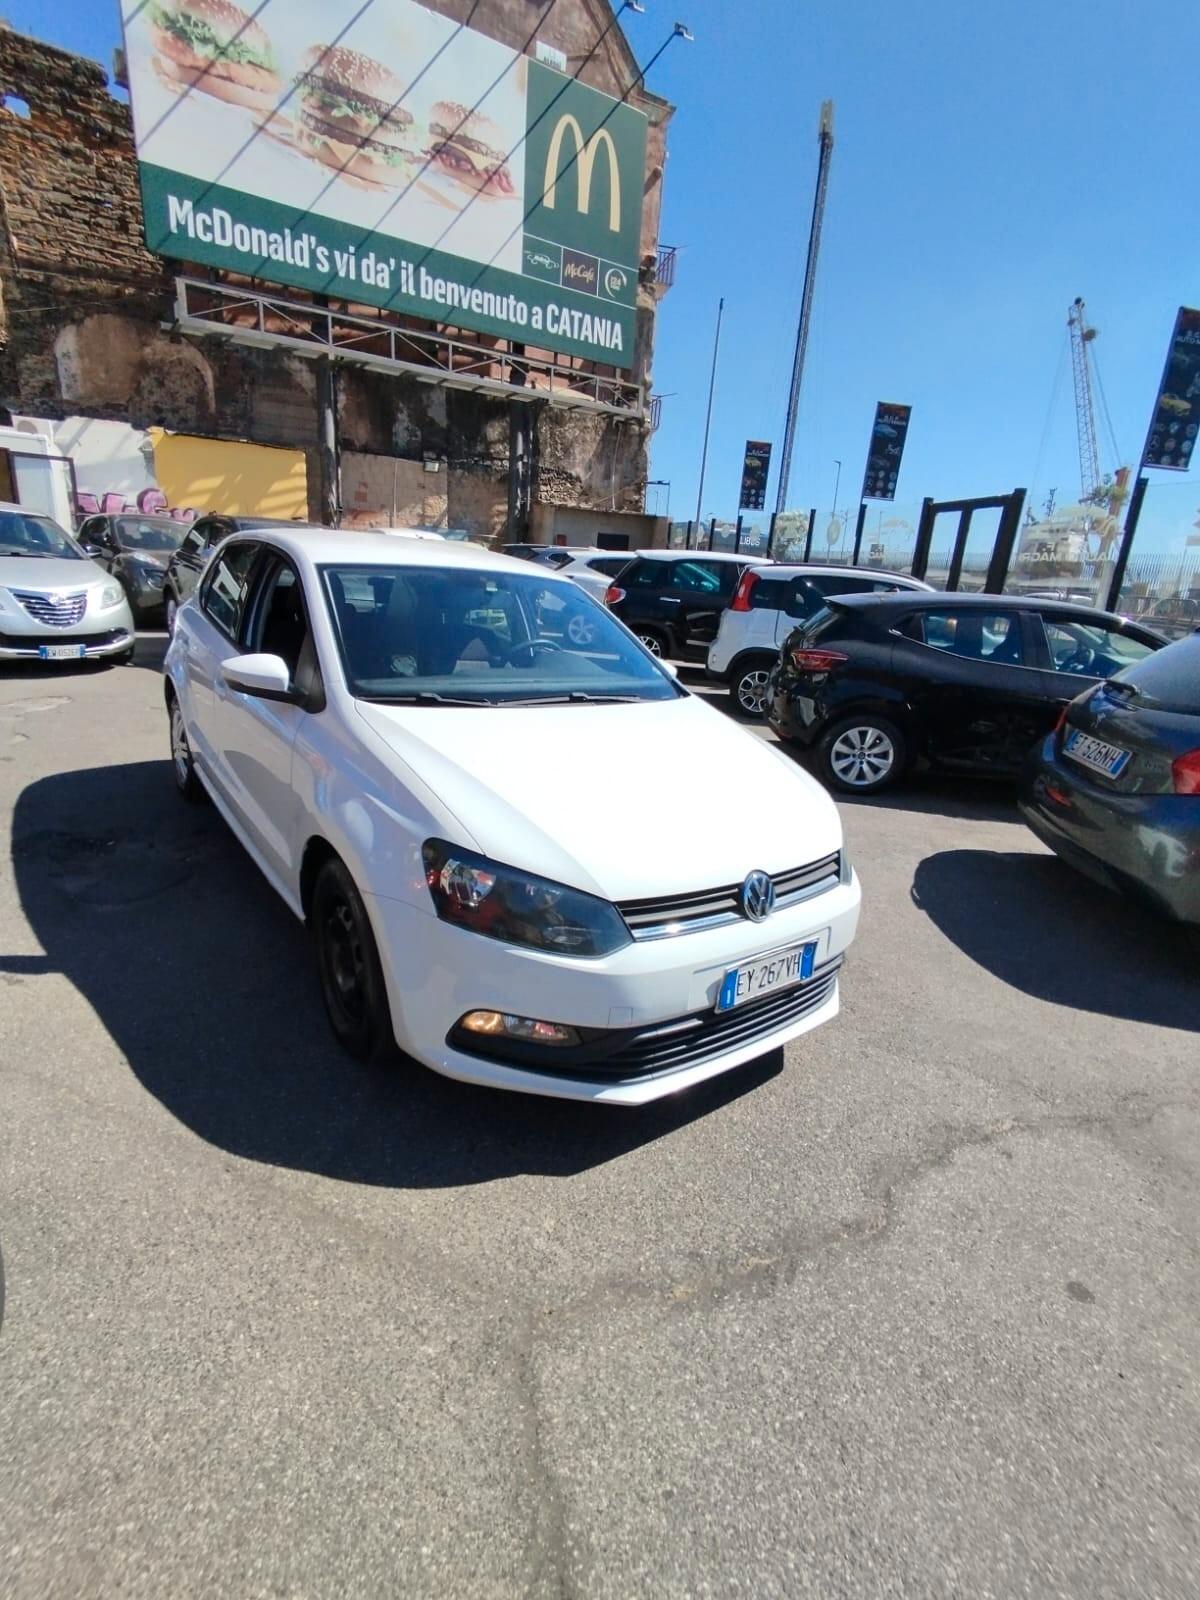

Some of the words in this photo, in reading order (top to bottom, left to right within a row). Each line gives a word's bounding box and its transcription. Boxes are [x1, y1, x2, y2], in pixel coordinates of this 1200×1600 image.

[167, 194, 330, 273] McDonald's
[333, 245, 356, 280] vi
[361, 251, 396, 289] da'
[401, 260, 416, 296] il
[420, 266, 528, 326] benvenuto
[531, 305, 543, 331] a
[546, 303, 624, 352] CATANIA
